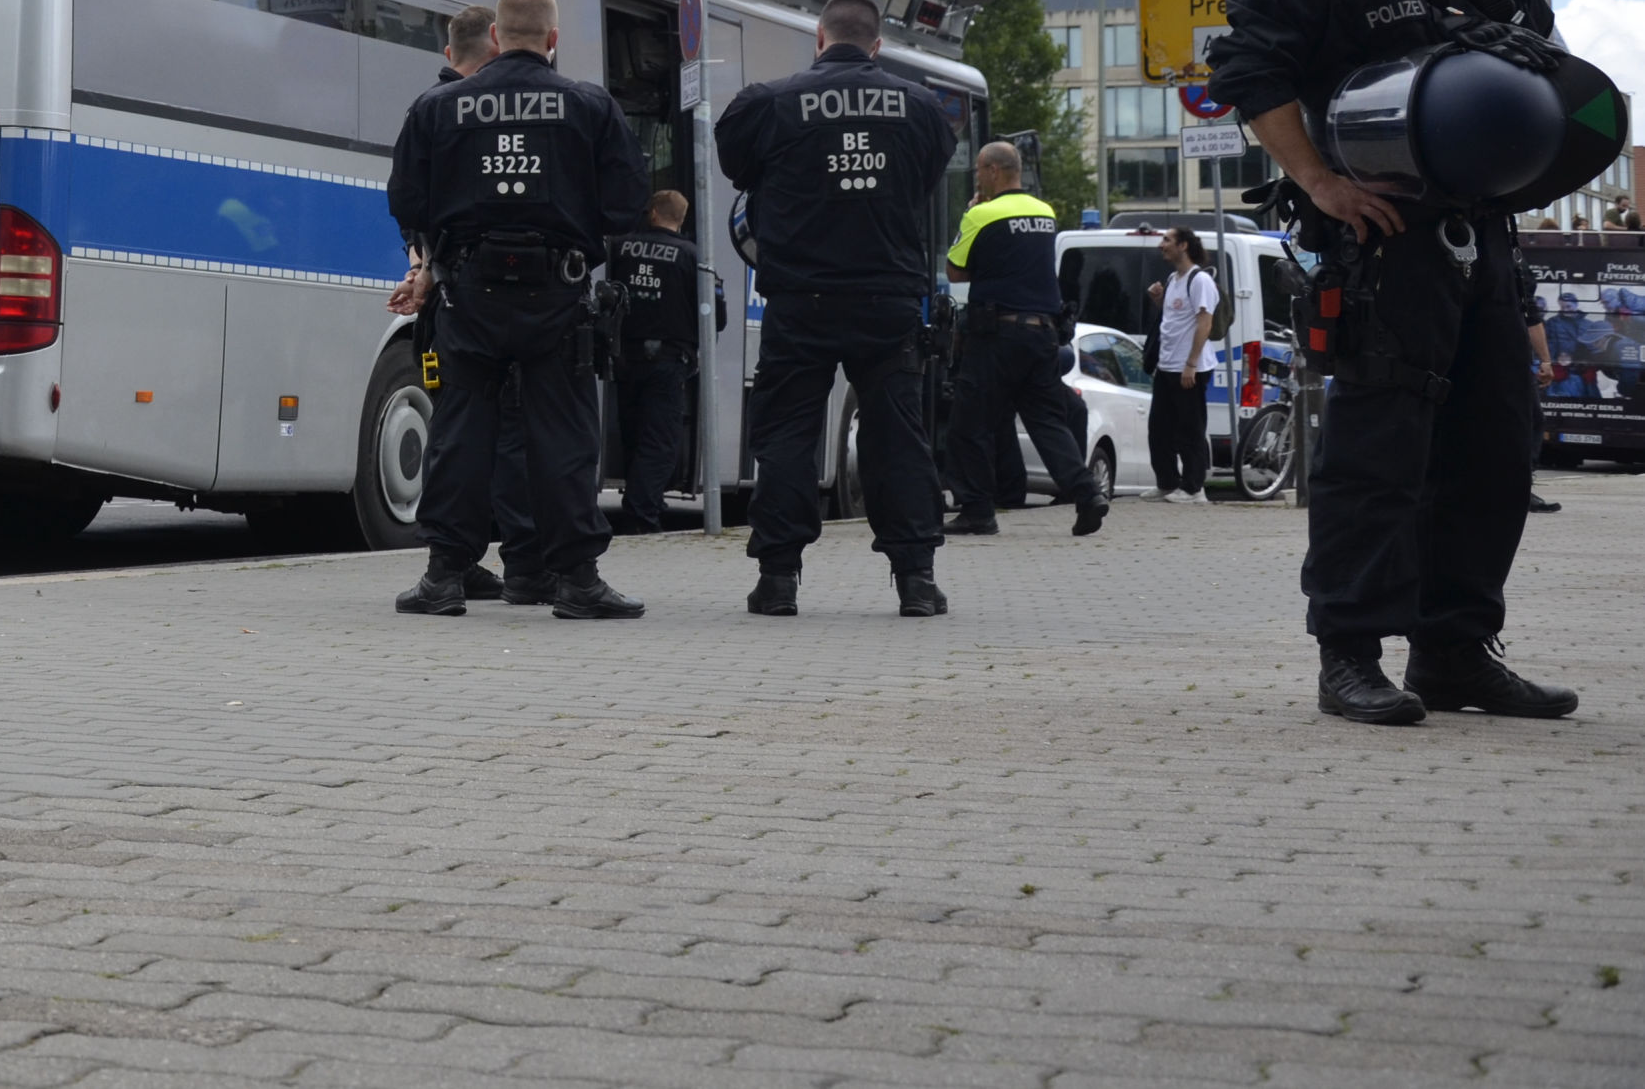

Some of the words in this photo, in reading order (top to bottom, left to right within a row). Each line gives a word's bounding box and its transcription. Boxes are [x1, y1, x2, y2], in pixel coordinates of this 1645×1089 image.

[1365, 0, 1426, 29] POLIZEI
[457, 92, 565, 125] POLIZEI
[800, 88, 906, 121] POLIZEI
[497, 134, 525, 152] BE
[843, 132, 870, 151] BE
[481, 155, 541, 174] 33222
[827, 152, 886, 172] 33200
[620, 241, 679, 263] POLIZEI
[638, 263, 654, 276] BE
[1607, 263, 1640, 272] POLAR
[629, 274, 661, 288] 16130
